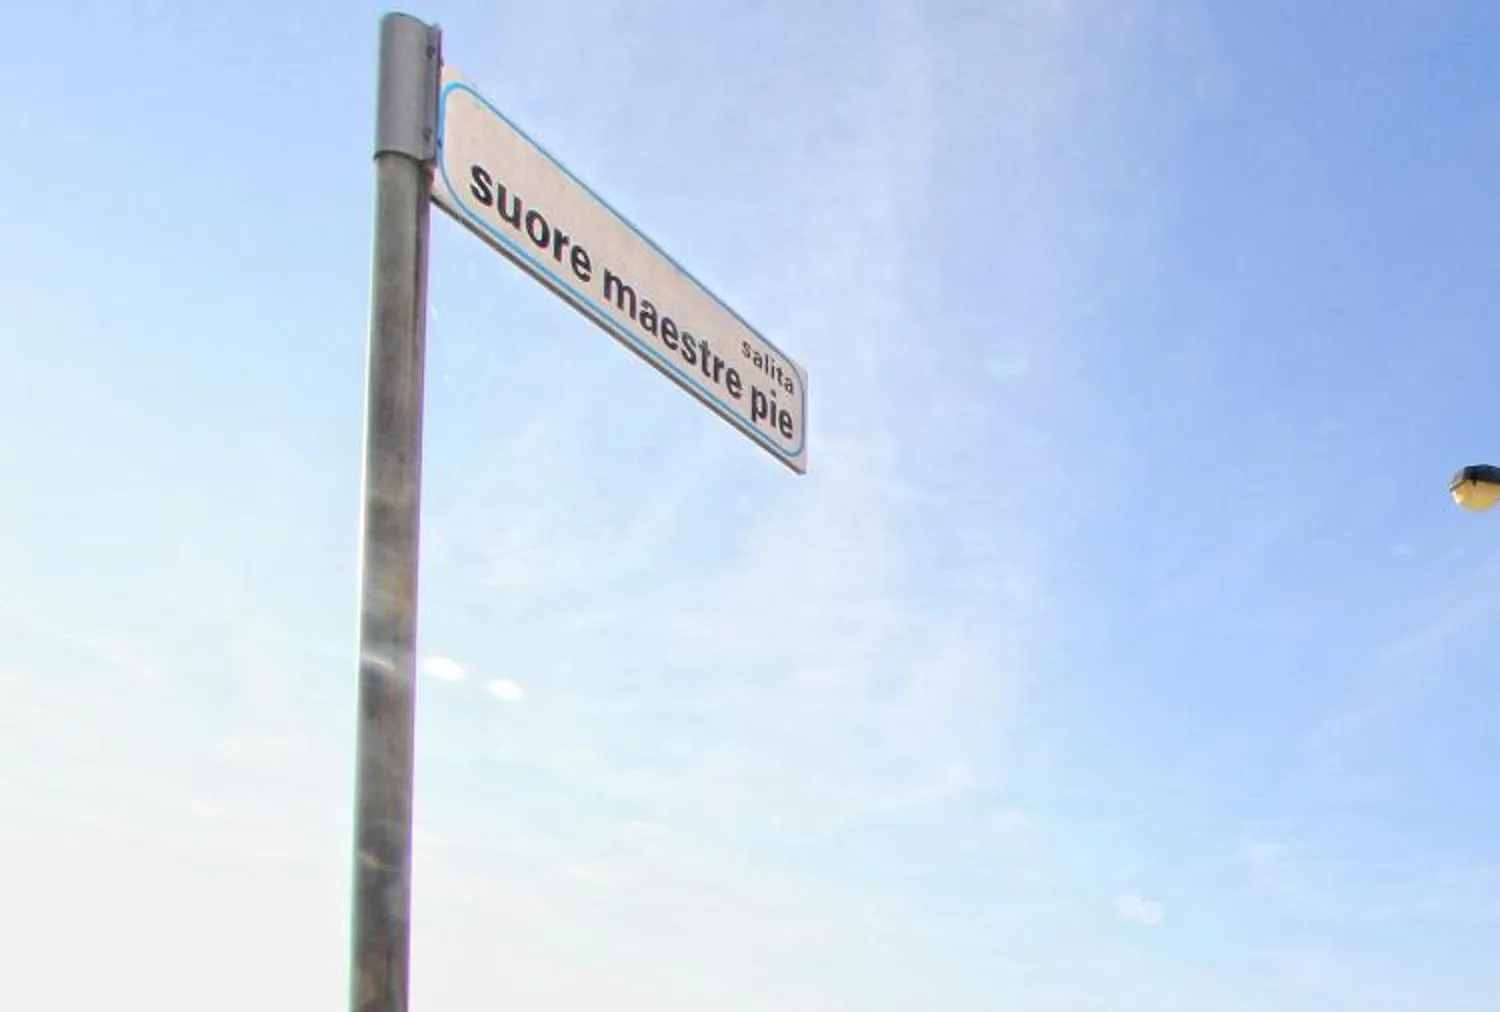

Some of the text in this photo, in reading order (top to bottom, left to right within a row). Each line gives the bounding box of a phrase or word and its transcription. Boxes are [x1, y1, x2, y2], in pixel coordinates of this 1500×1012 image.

[469, 164, 793, 439] suore maestre pie
[741, 340, 795, 395] salita
